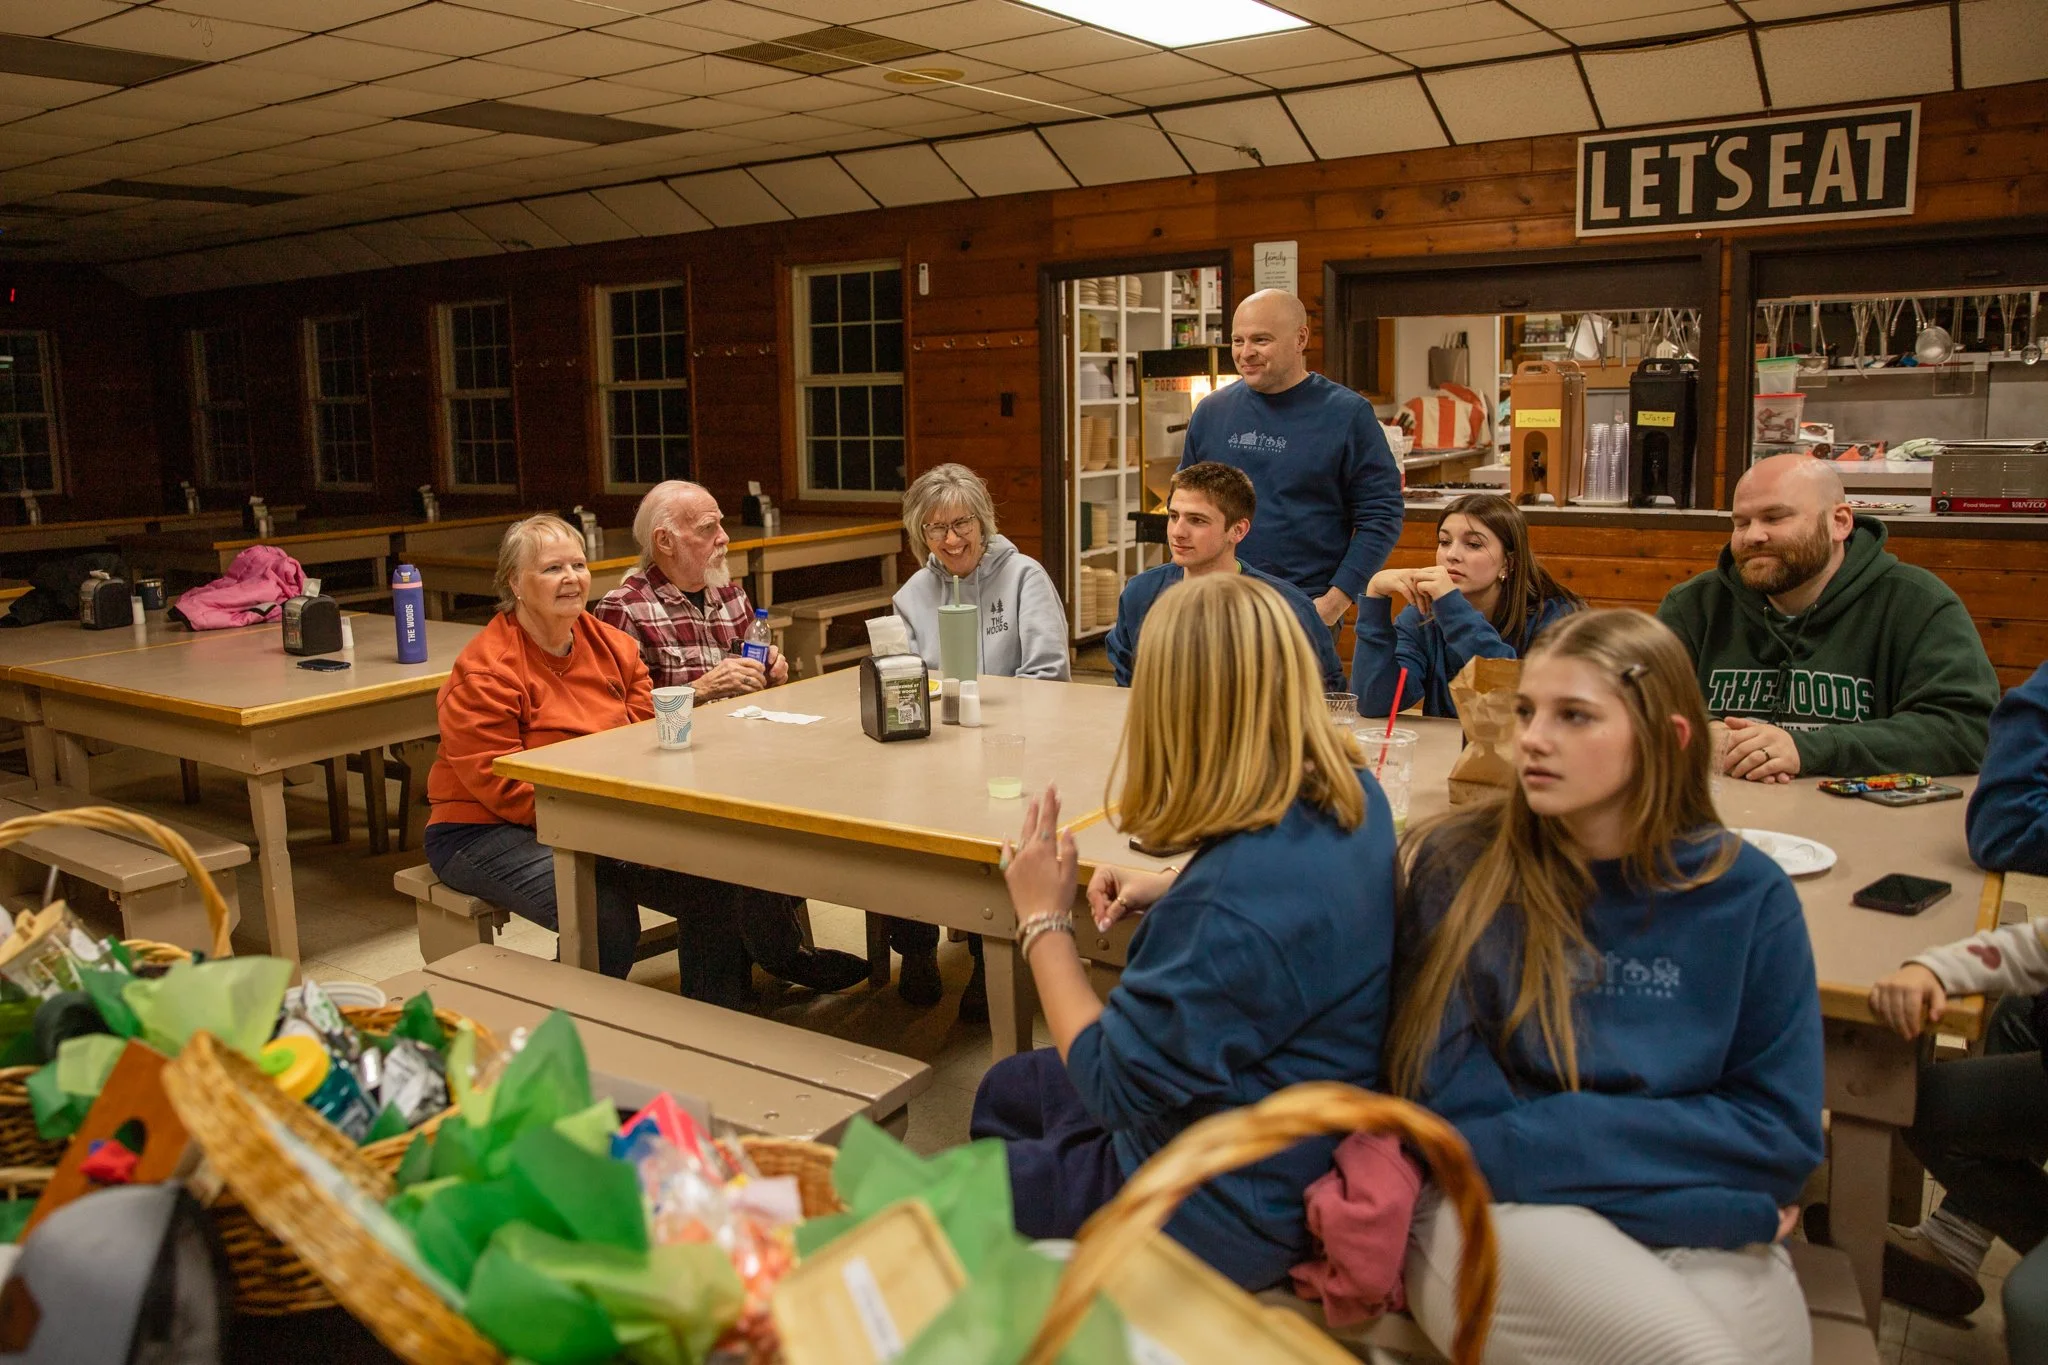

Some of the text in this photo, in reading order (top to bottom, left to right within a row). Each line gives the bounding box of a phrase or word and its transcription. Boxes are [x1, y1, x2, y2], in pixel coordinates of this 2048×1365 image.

[1590, 122, 1901, 221] LET'S EAT
[1154, 378, 1190, 391] POPCOR
[1642, 413, 1672, 422] Water
[405, 604, 416, 643] THE WOODS
[991, 615, 1004, 626] THE
[986, 622, 1009, 636] WOODS
[1708, 669, 1780, 713] THE
